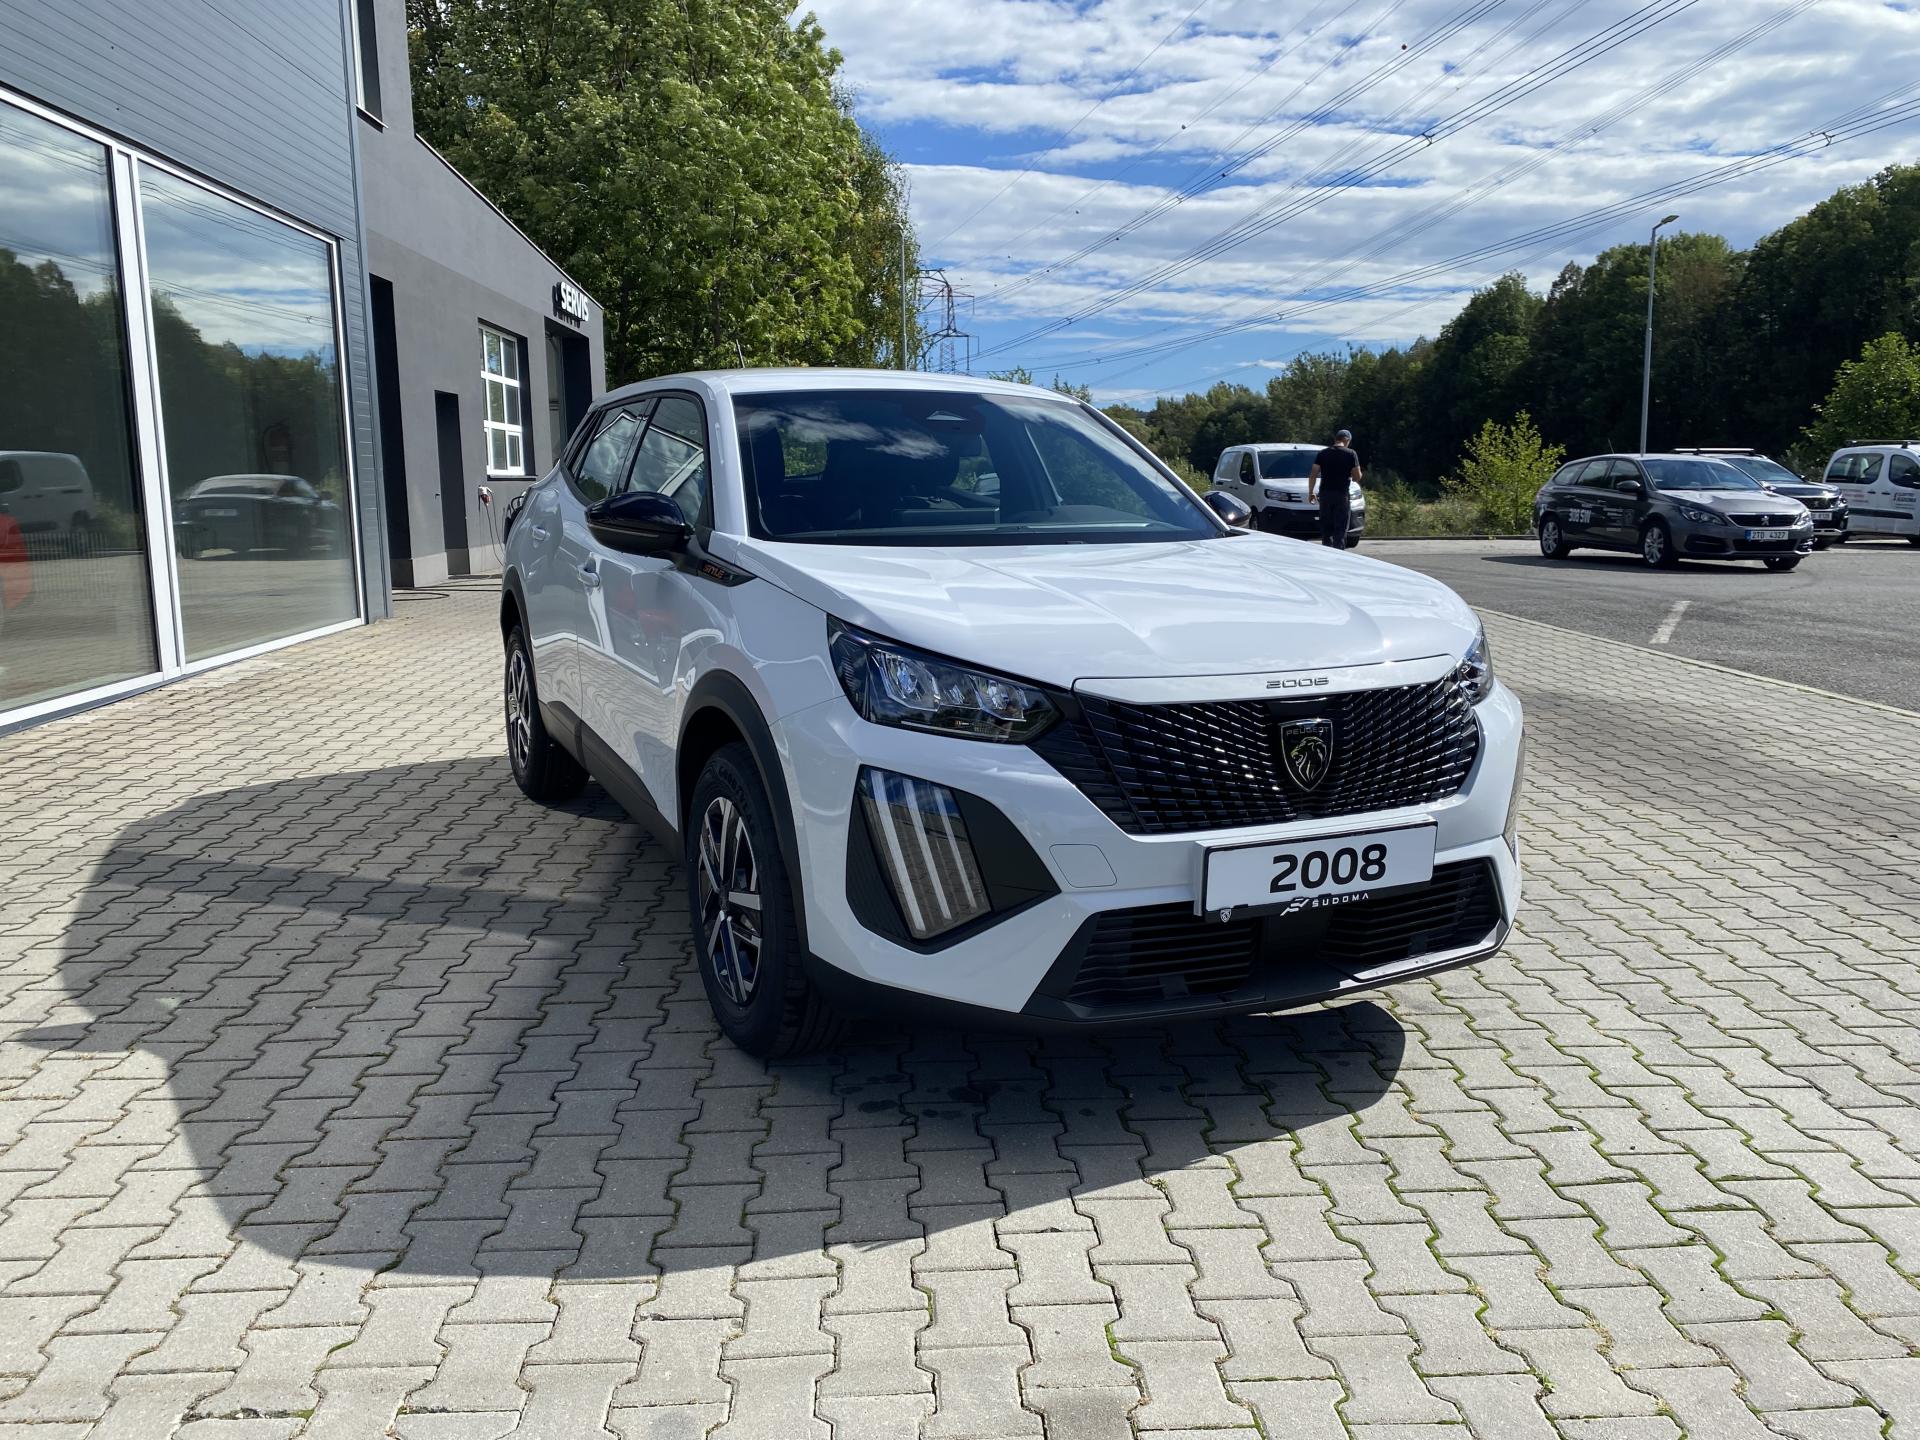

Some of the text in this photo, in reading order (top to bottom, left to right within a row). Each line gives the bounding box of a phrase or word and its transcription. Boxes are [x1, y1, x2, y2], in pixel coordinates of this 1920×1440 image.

[560, 281, 589, 322] SERVIS
[703, 564, 726, 579] STYLE
[1286, 726, 1330, 736] PEUGEOT
[1269, 843, 1388, 894] 2008
[1311, 892, 1370, 908] SUDOMA
